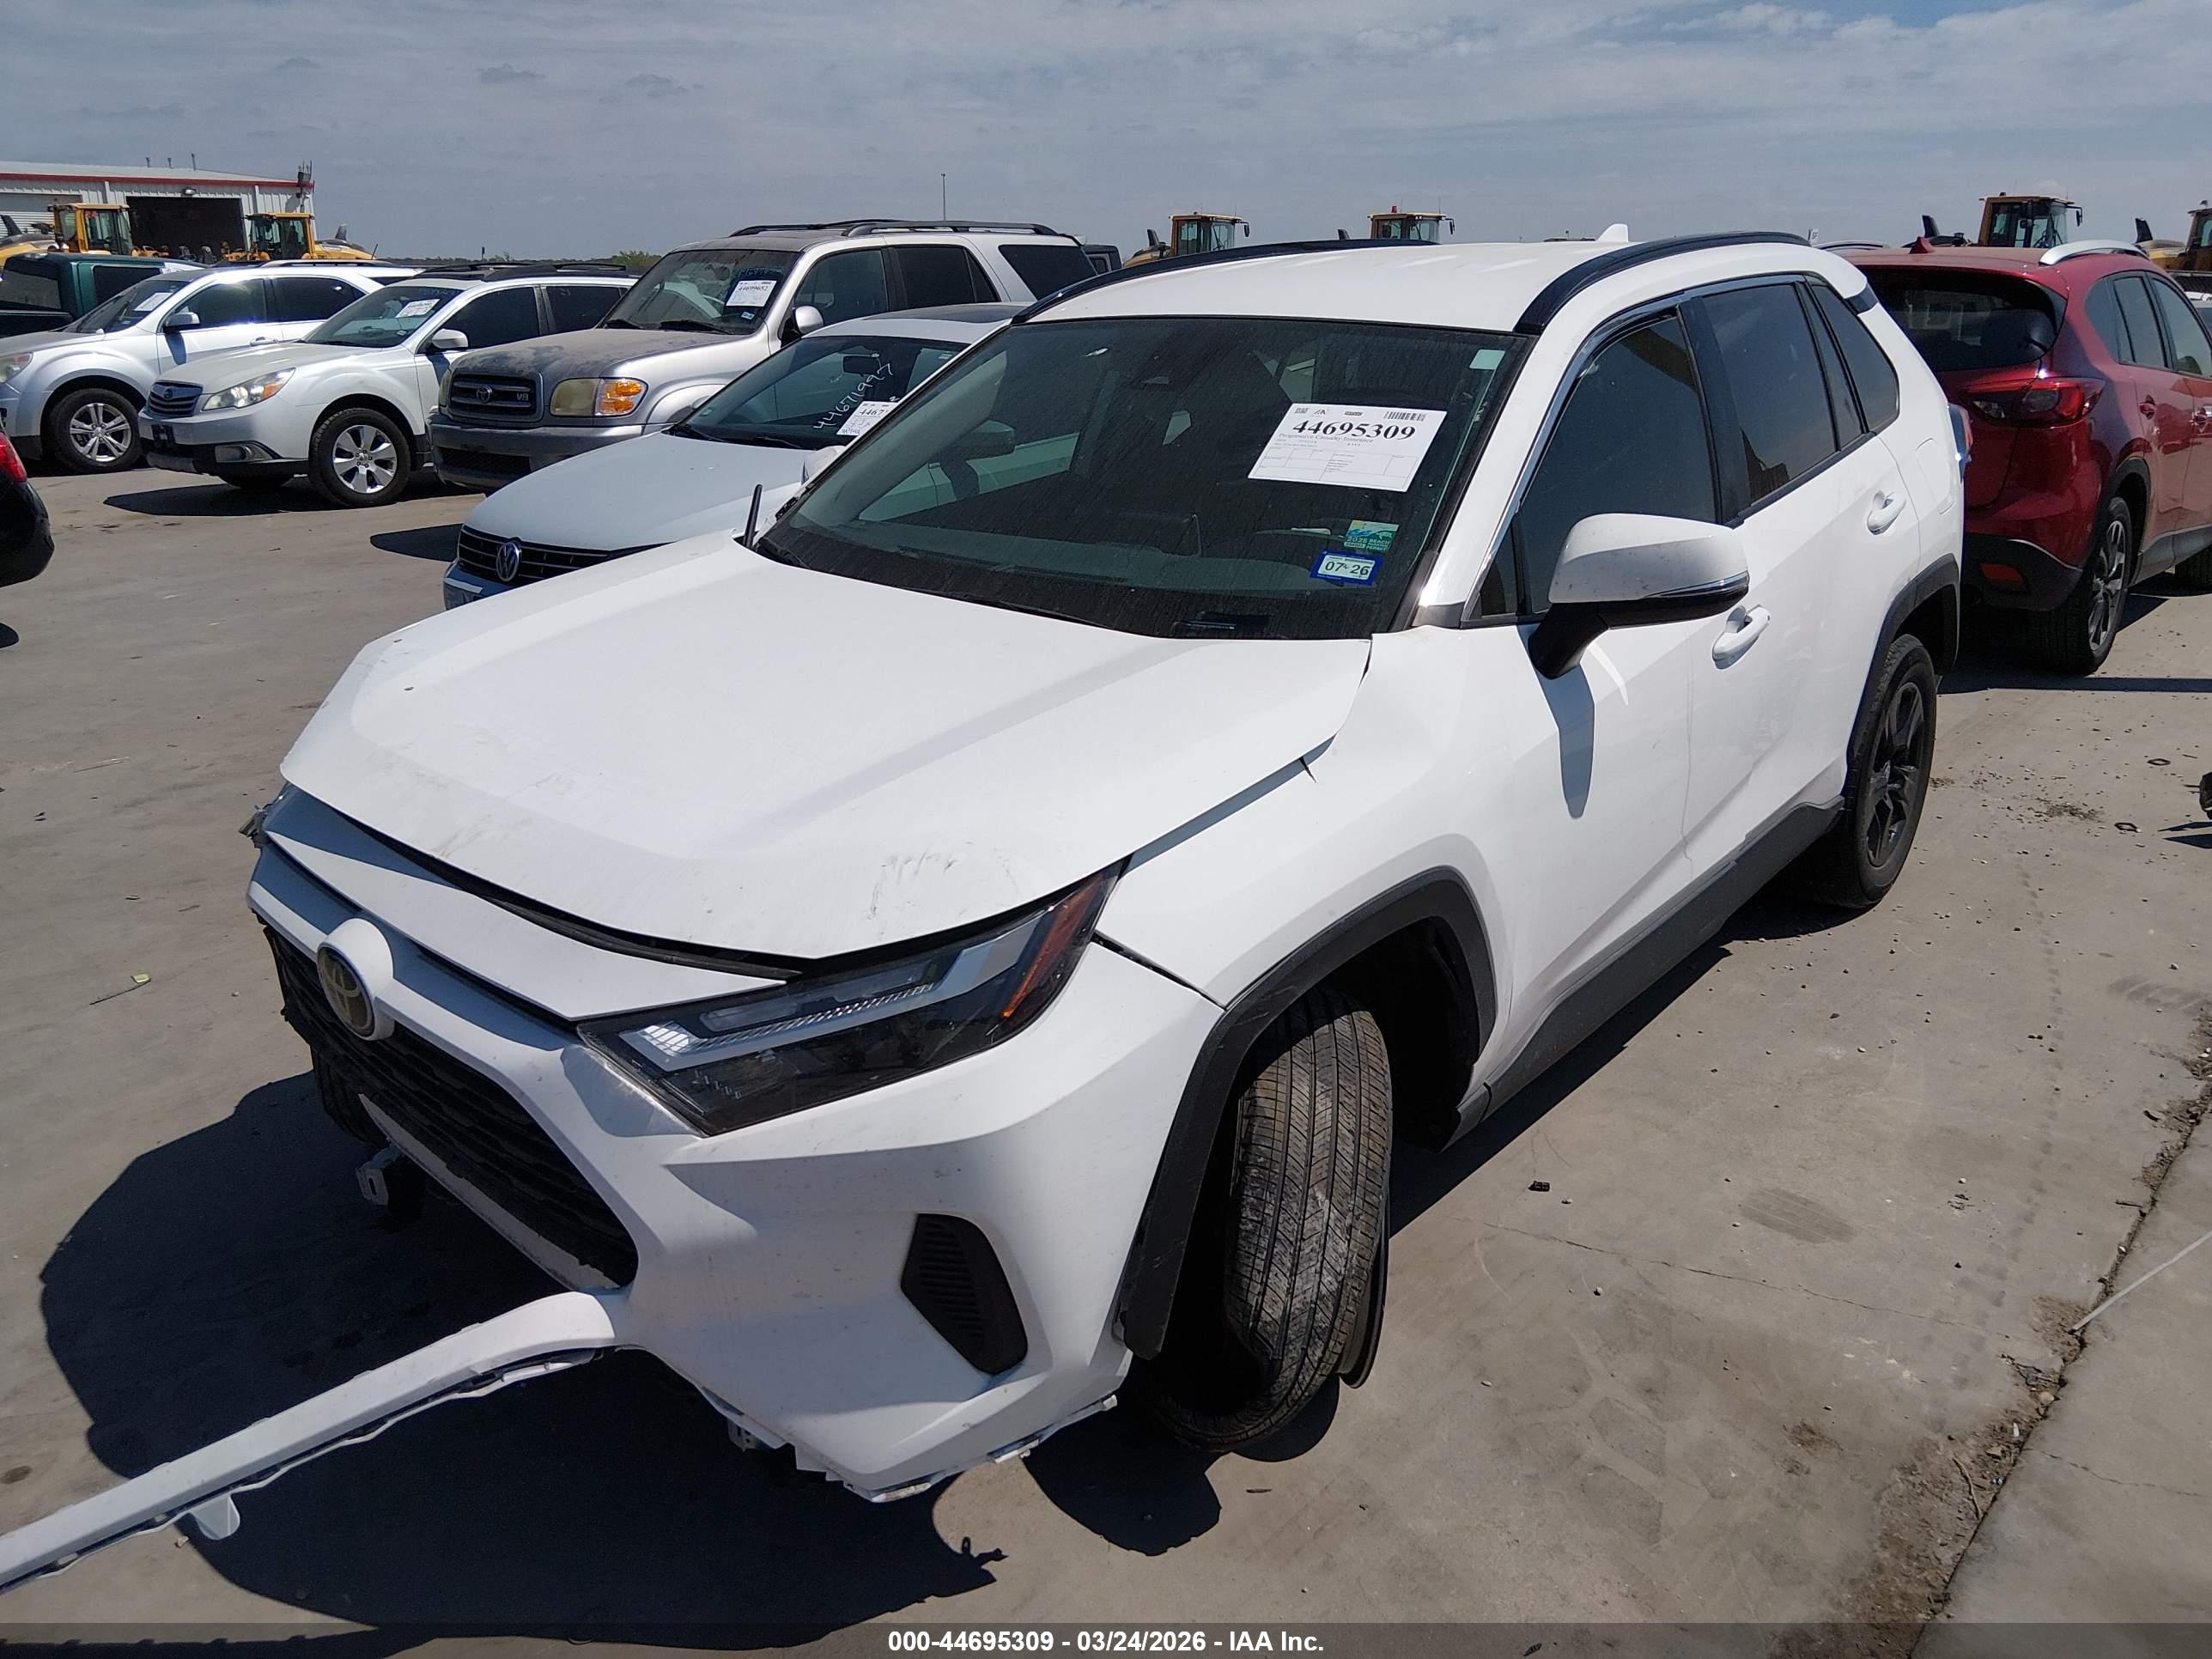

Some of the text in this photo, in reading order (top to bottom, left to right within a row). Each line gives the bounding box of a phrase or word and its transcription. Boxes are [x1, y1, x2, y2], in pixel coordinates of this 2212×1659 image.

[516, 392, 529, 401] V8
[812, 362, 894, 428] 44671997
[1292, 420, 1416, 441] 44695309
[1325, 561, 1370, 575] 07 26
